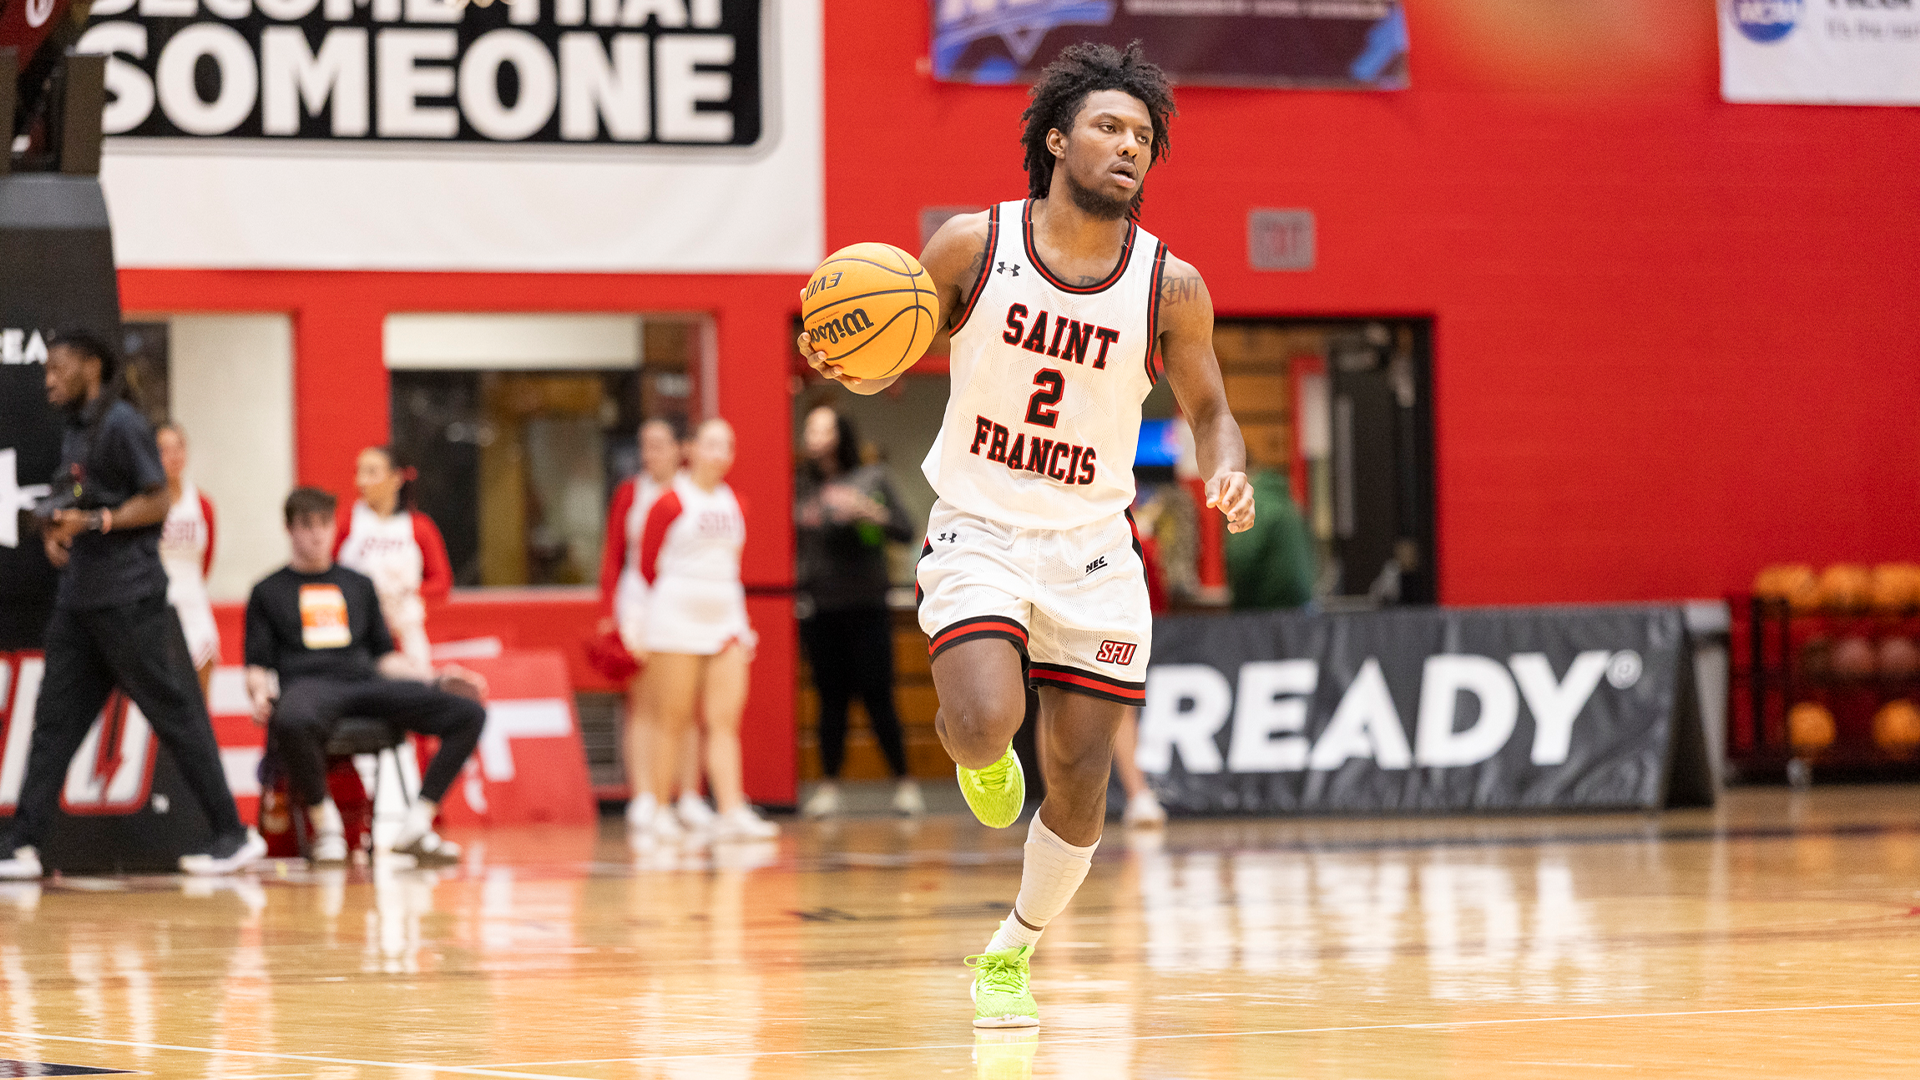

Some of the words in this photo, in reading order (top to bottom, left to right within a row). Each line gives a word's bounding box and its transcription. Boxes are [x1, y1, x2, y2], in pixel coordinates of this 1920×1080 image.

[76, 21, 735, 143] SOMEONE
[1002, 302, 1120, 370] SAINT
[1024, 367, 1065, 429] 2
[970, 415, 1097, 485] FRANCIS
[1085, 556, 1105, 574] NEC
[1096, 640, 1137, 665] SFU
